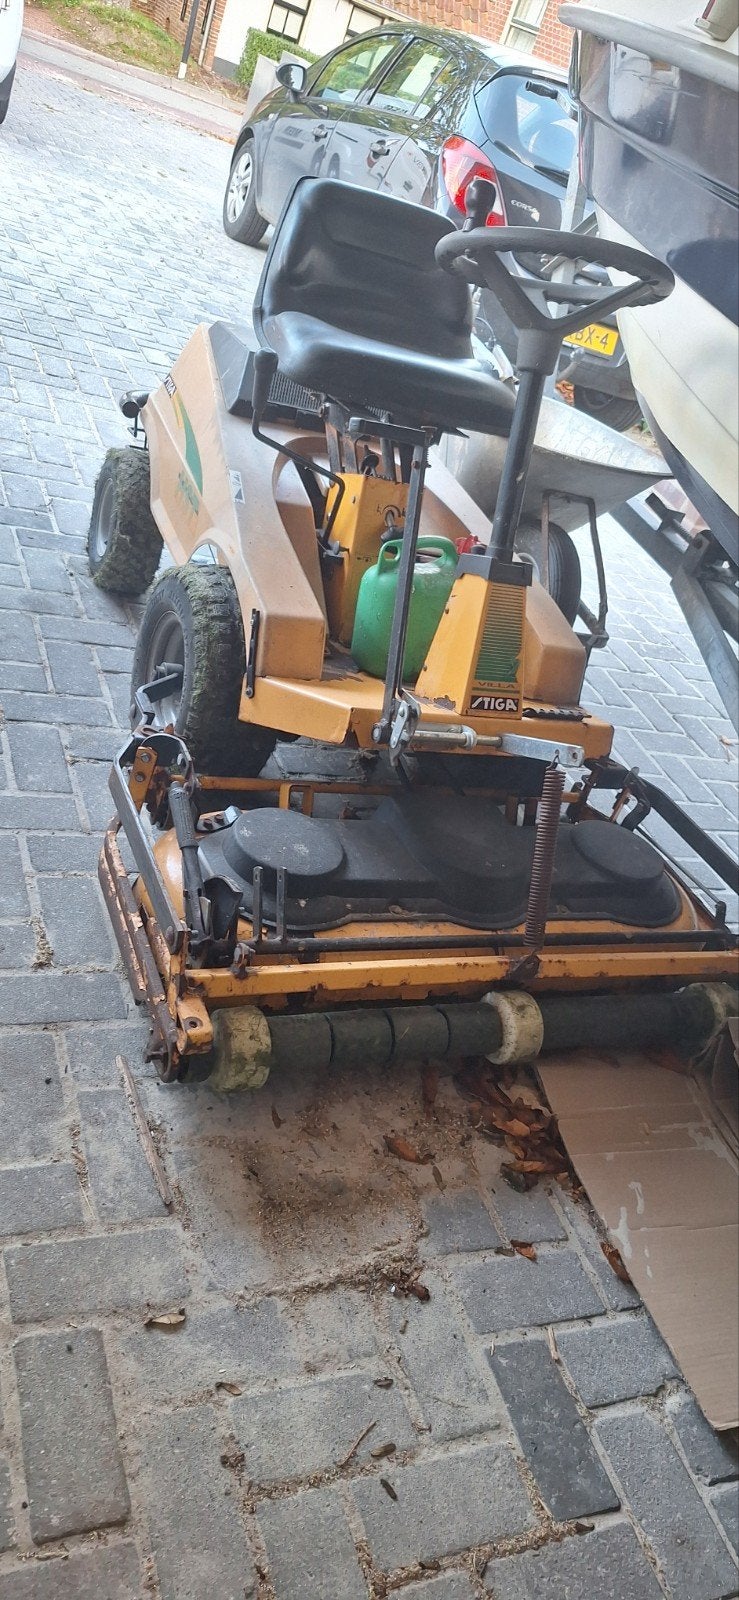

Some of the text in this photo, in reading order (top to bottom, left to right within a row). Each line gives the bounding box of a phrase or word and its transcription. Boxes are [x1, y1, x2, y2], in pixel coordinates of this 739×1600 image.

[569, 327, 609, 349] BX-4
[478, 681, 516, 689] VILLA
[471, 697, 517, 711] STIGA
